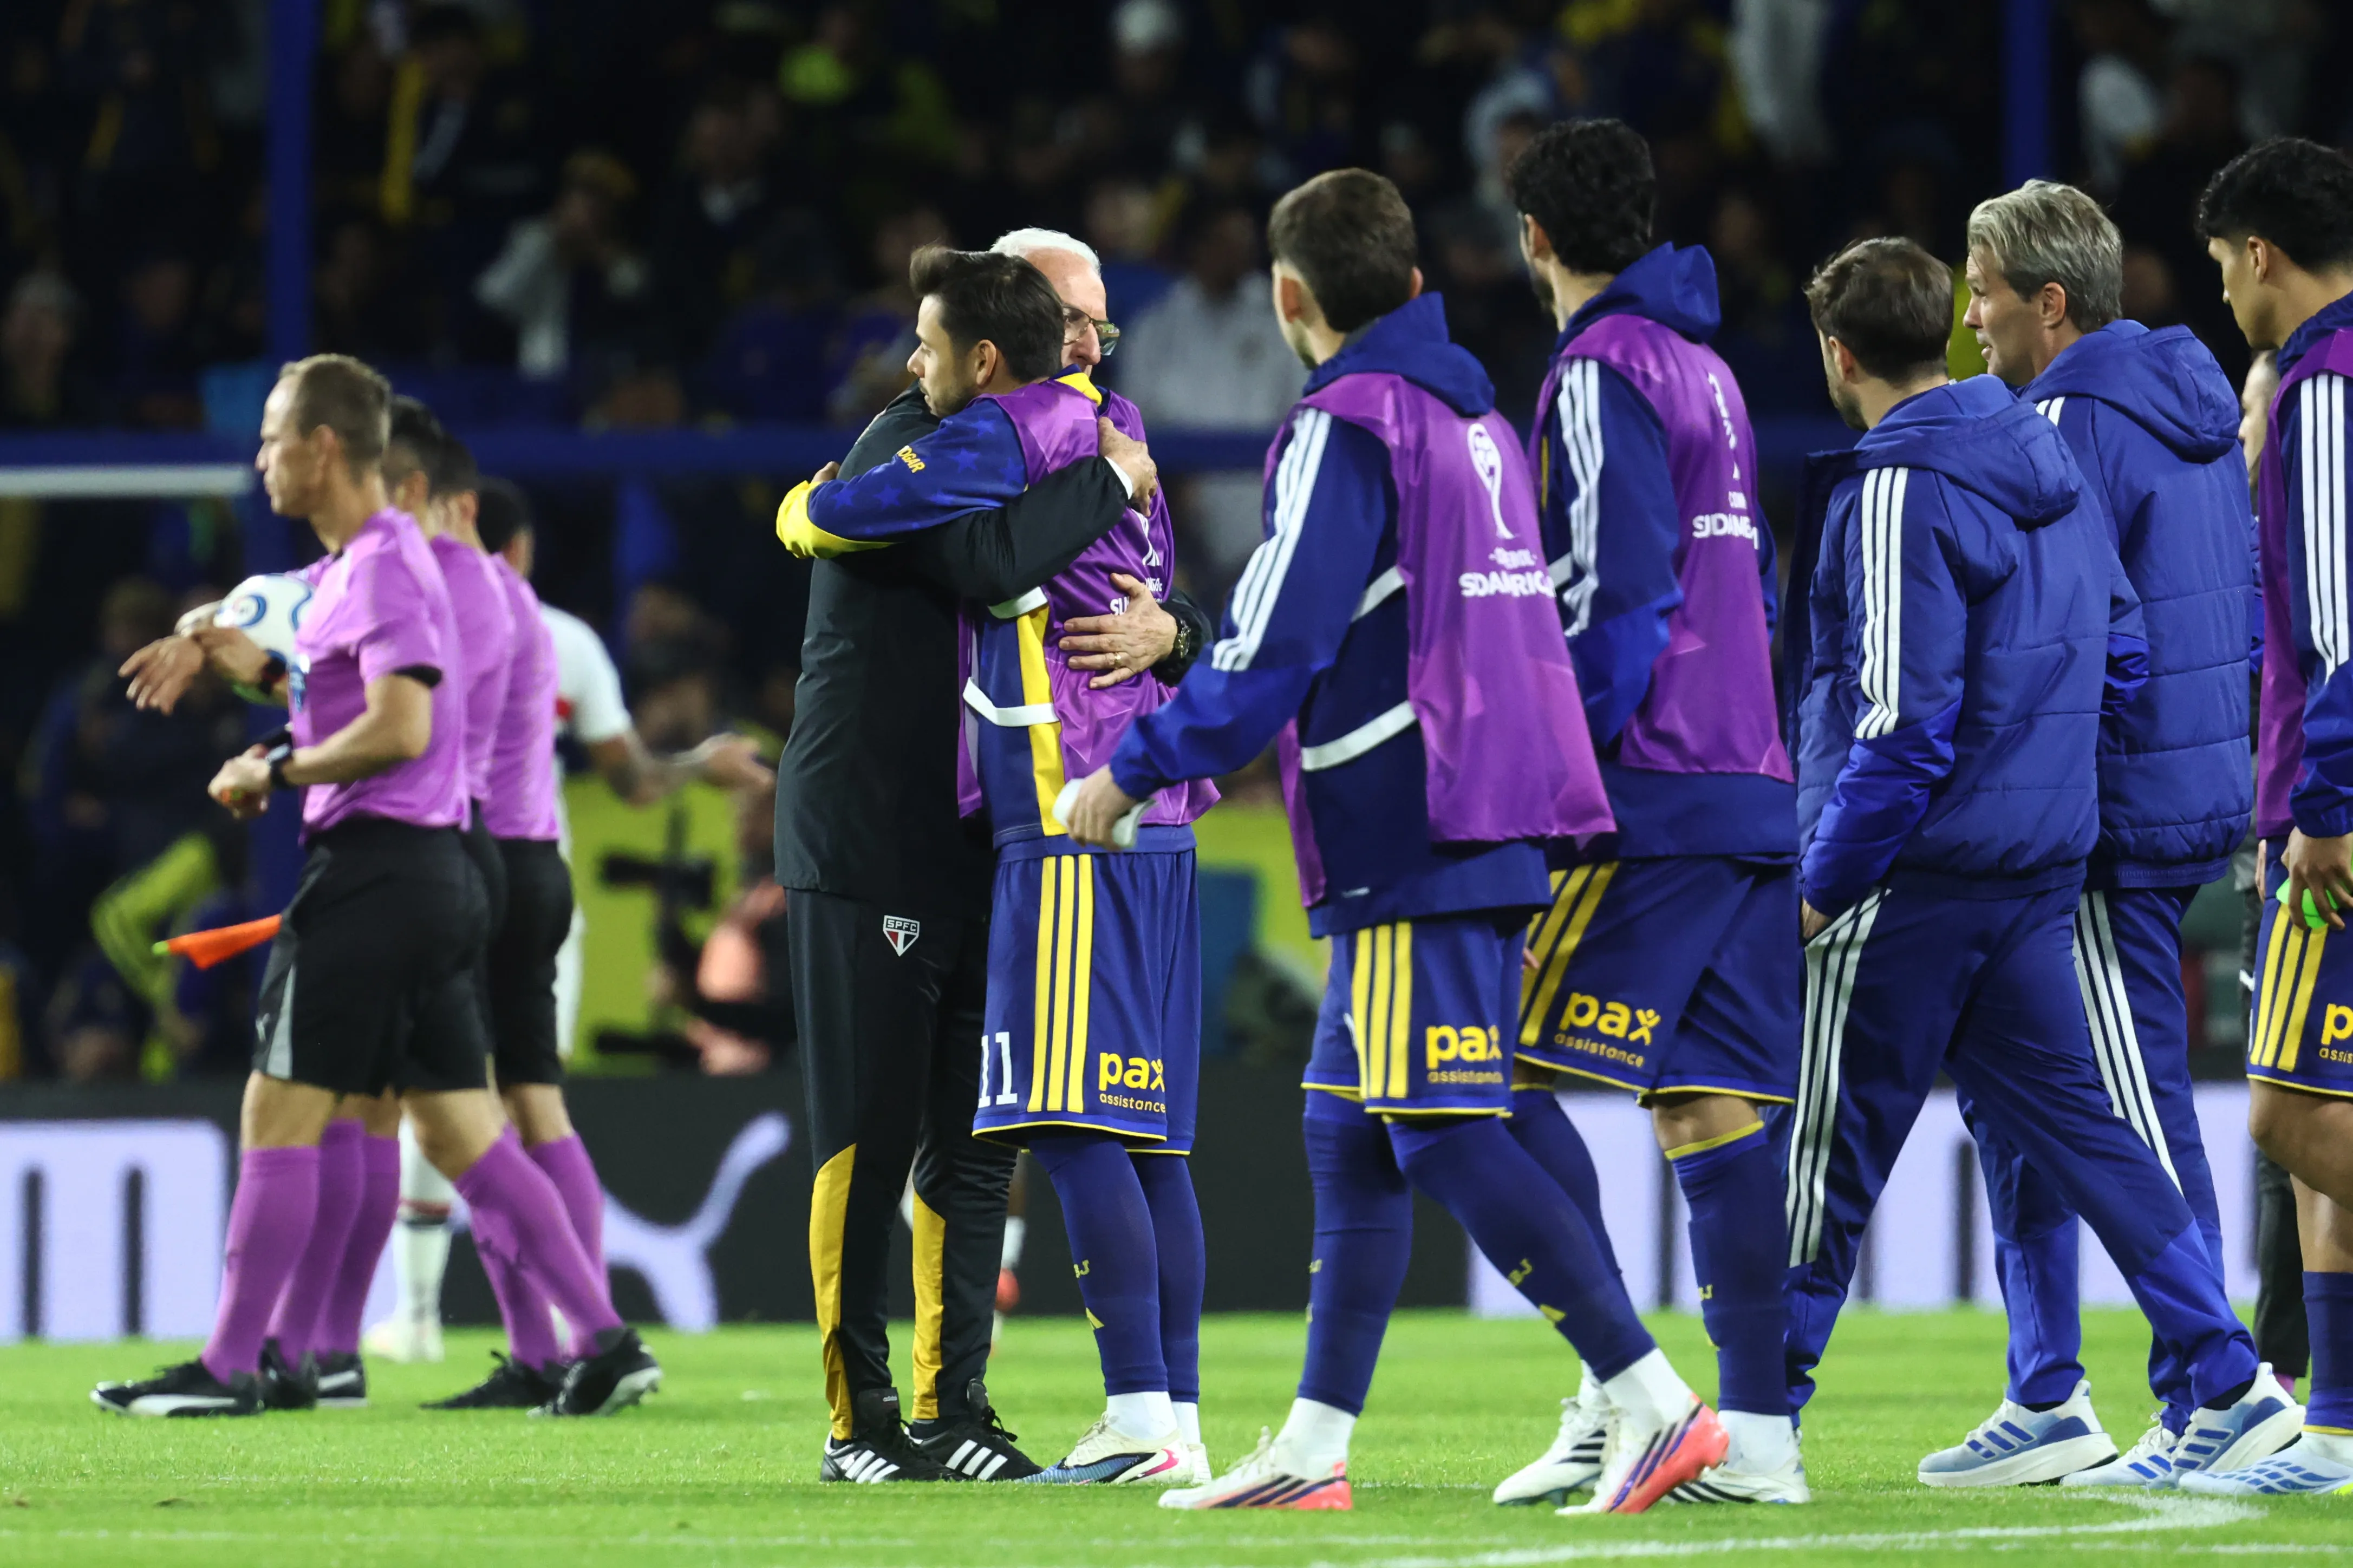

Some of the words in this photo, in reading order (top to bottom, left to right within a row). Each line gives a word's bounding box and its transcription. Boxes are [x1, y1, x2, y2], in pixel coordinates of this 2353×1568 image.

[887, 919, 916, 931] SPFC
[1557, 992, 1661, 1046] pax
[2321, 1003, 2353, 1046] p
[1425, 1024, 1503, 1070] pax
[1554, 1033, 1645, 1068] assistance
[2319, 1047, 2353, 1064] assis
[978, 1032, 1018, 1108] 11
[1099, 1052, 1165, 1093] pax
[1099, 1093, 1166, 1114] assistance
